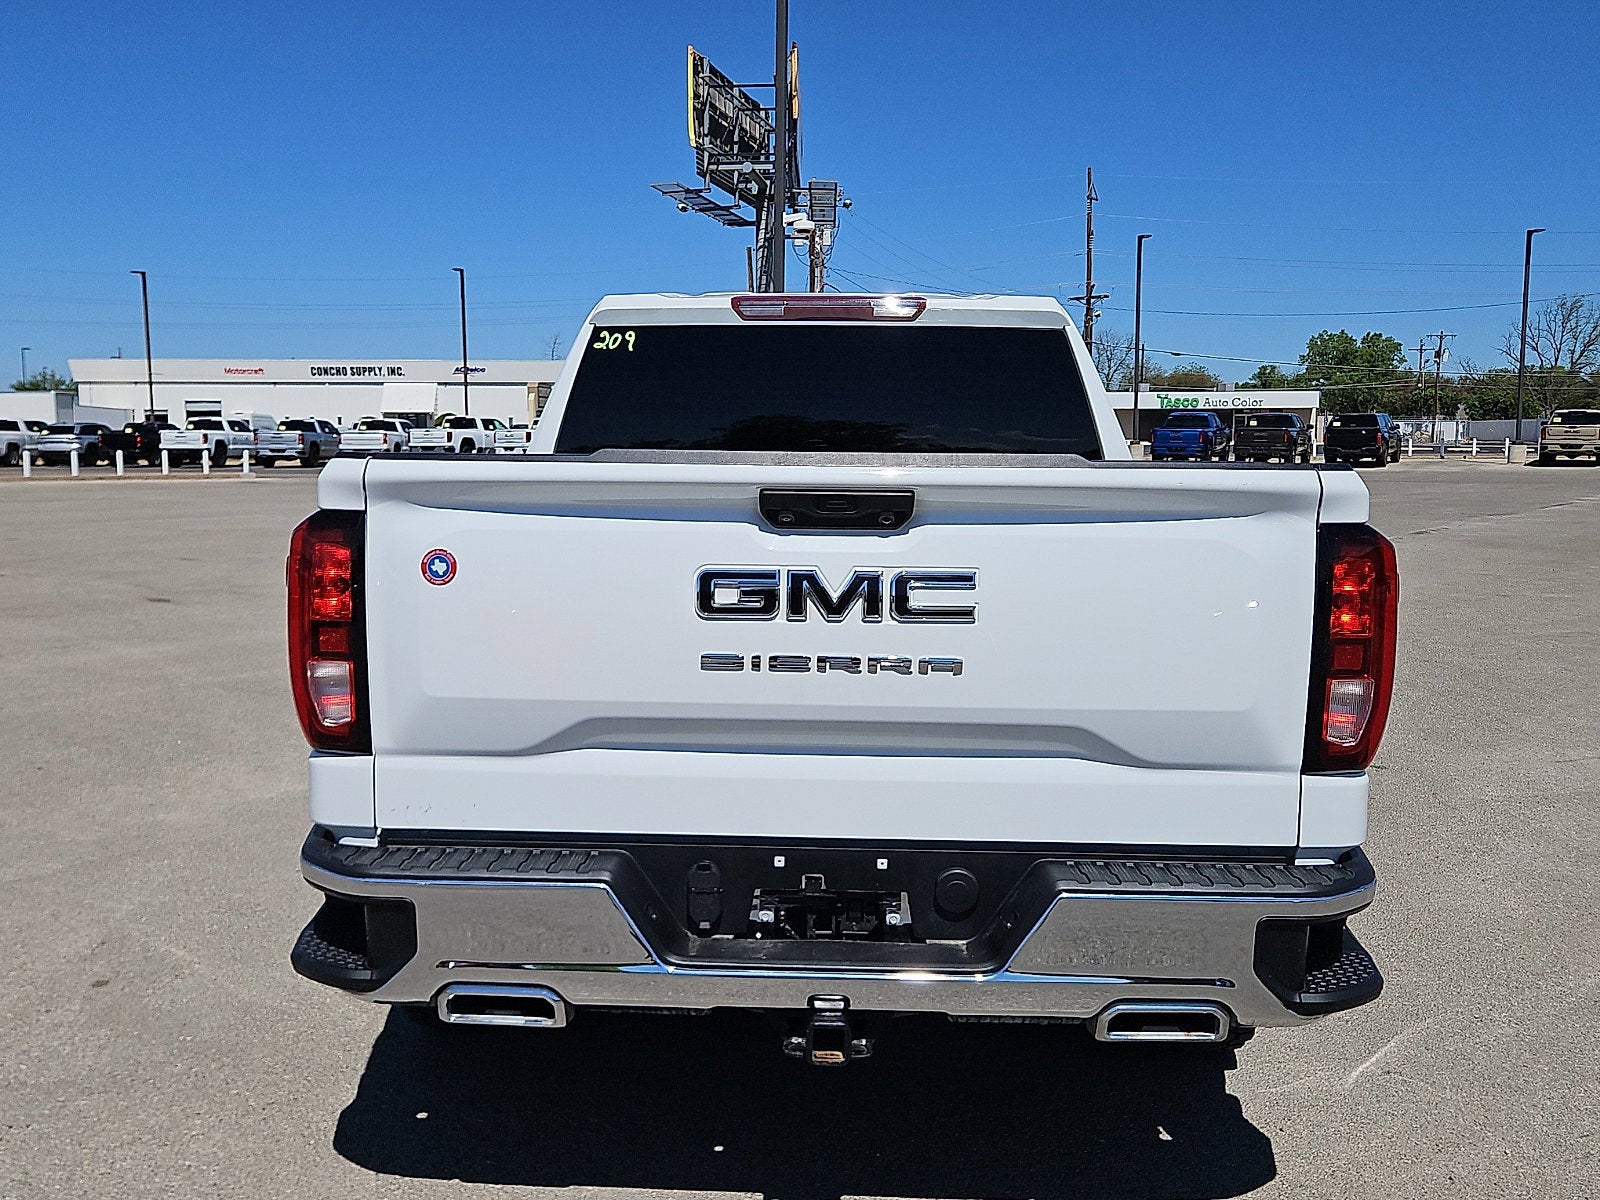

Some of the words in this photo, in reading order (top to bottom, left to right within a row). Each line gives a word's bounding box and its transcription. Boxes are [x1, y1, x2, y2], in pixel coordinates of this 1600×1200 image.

[593, 330, 636, 351] 209
[310, 366, 347, 376] CONCHO
[349, 366, 385, 377] SUPPLY,
[386, 366, 405, 376] INC.
[1203, 397, 1229, 407] Auto
[1231, 397, 1264, 407] Color
[695, 565, 979, 624] GMC
[700, 652, 964, 676] SIERRA
